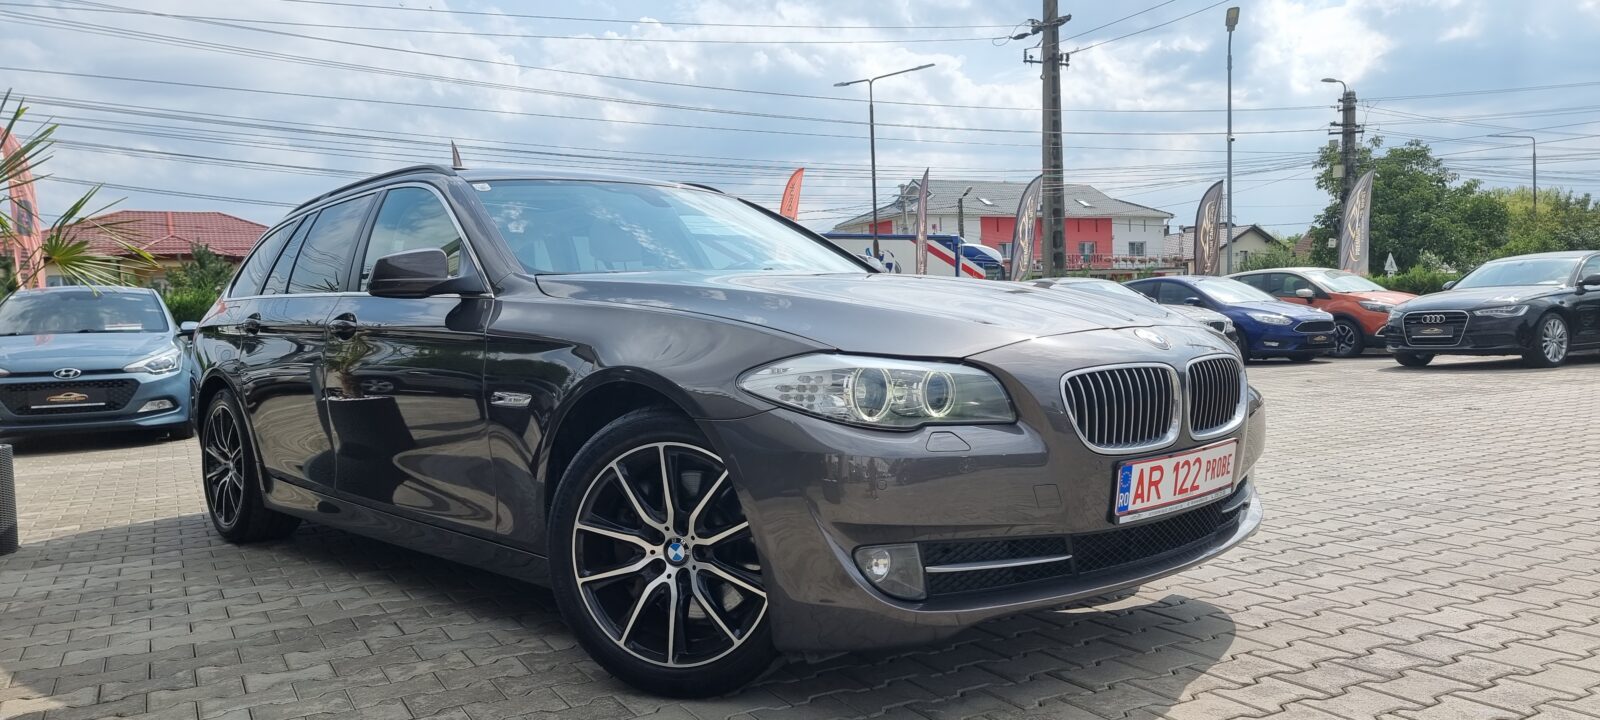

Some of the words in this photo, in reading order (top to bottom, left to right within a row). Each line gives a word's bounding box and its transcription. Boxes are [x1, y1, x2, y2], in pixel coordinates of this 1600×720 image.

[1132, 464, 1164, 505] AR
[1173, 456, 1202, 497] 122
[1204, 453, 1233, 482] PROBE
[1118, 492, 1129, 508] RO
